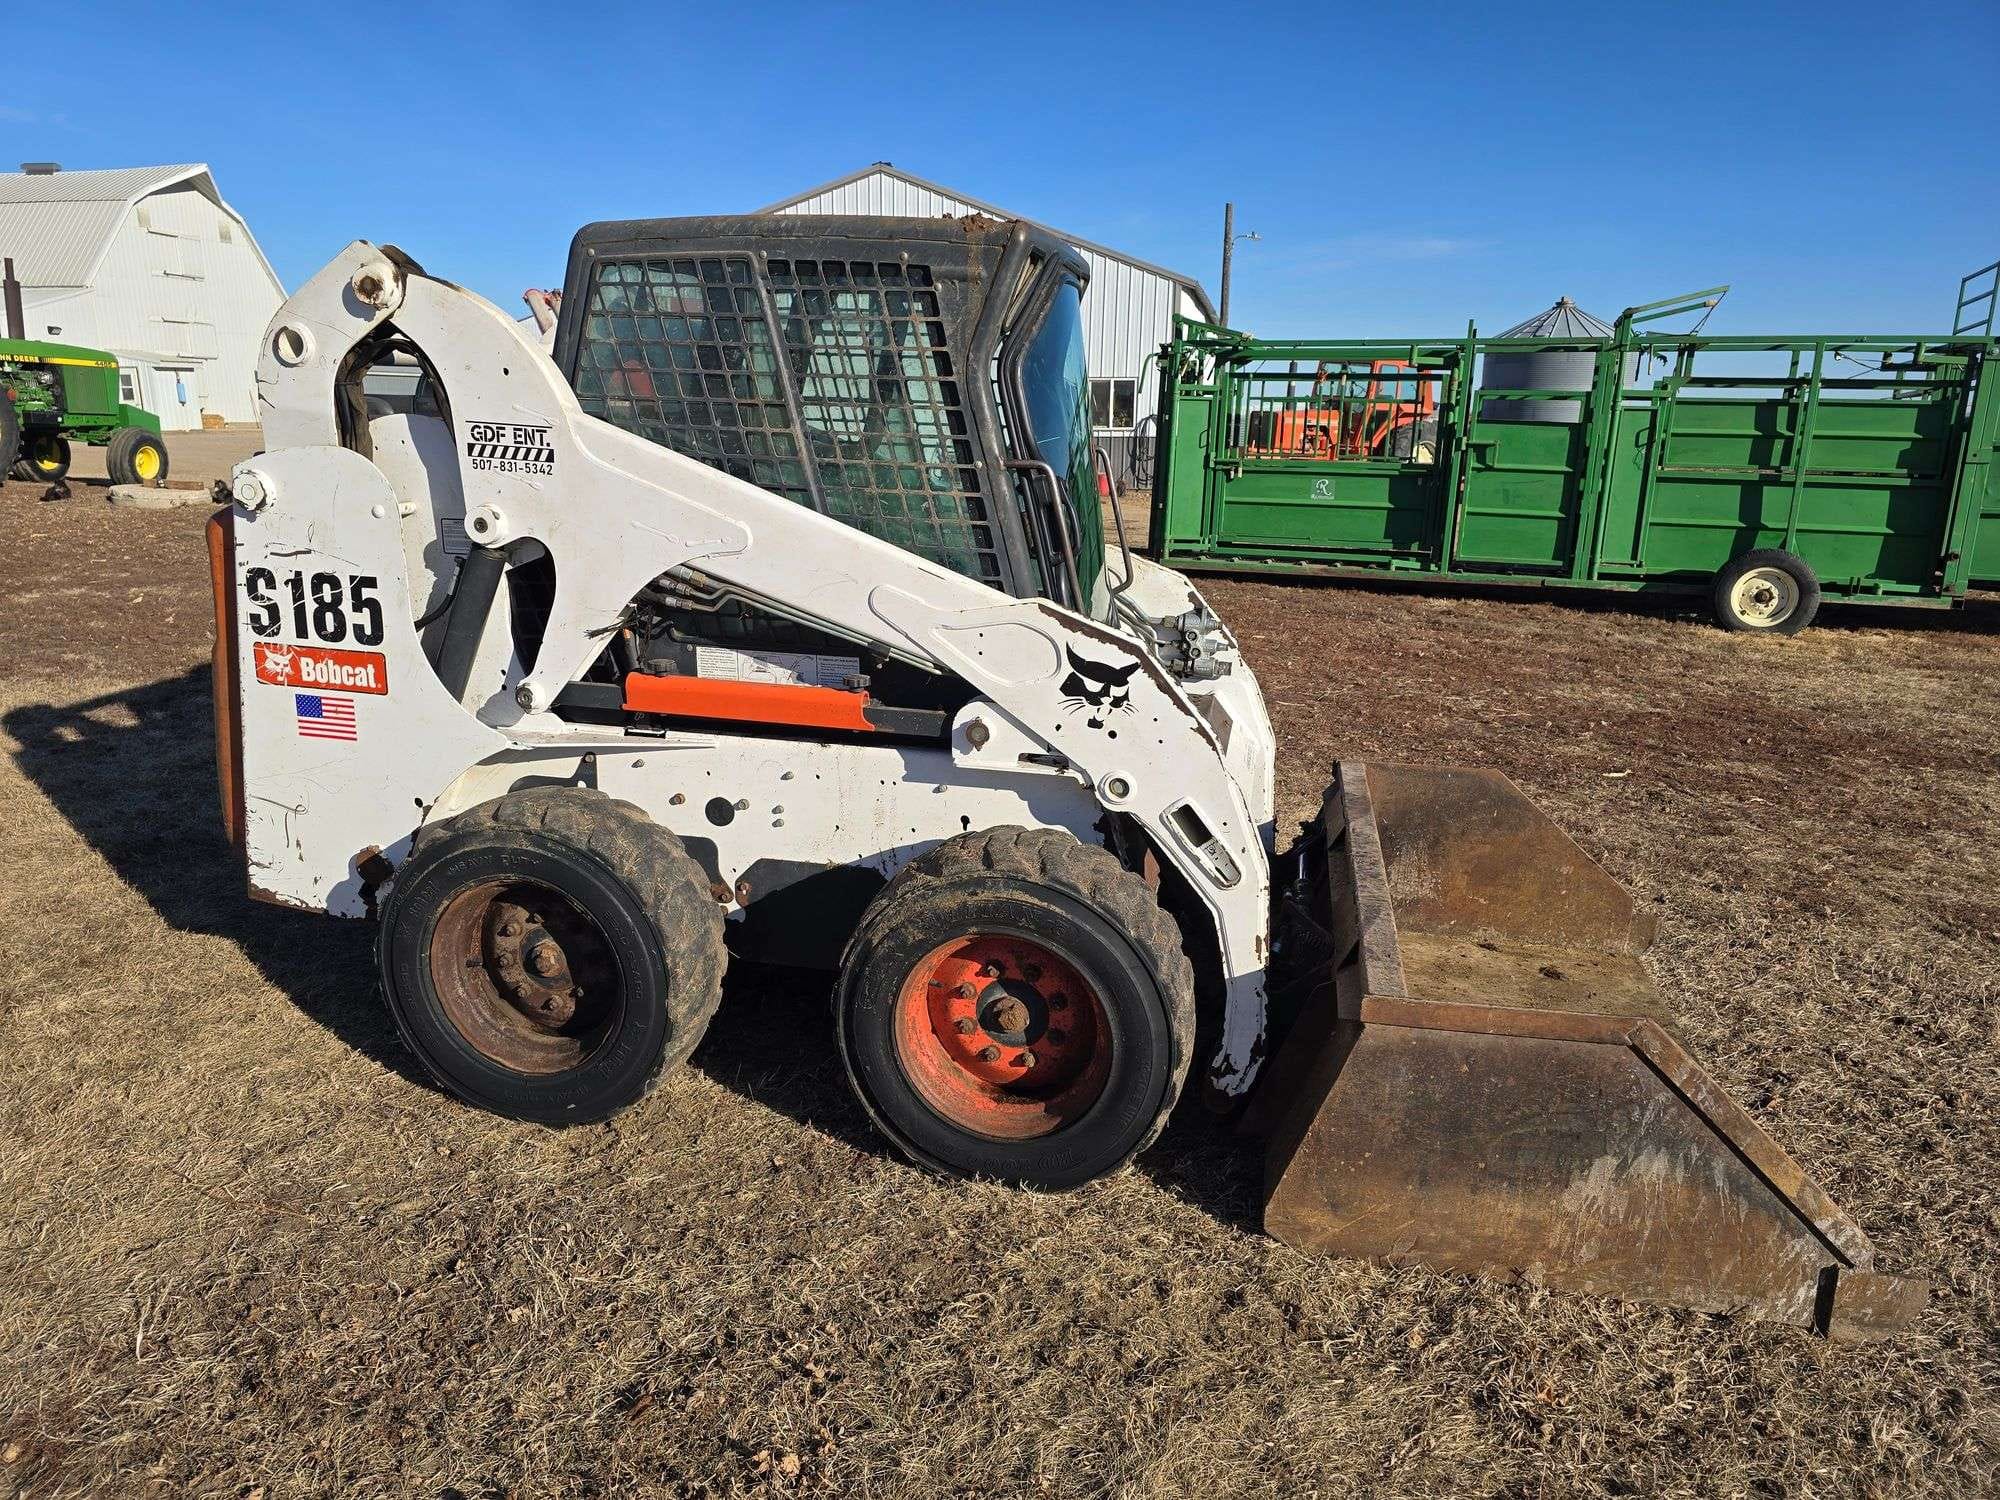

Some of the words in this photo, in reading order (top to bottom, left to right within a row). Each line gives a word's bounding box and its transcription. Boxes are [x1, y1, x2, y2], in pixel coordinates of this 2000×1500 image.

[13, 354, 40, 363] DEERE
[470, 424, 506, 443] GDF
[512, 427, 551, 448] ENT.
[472, 458, 553, 476] 507-831-5342
[246, 567, 384, 646] S185
[300, 656, 377, 688] Bobcat
